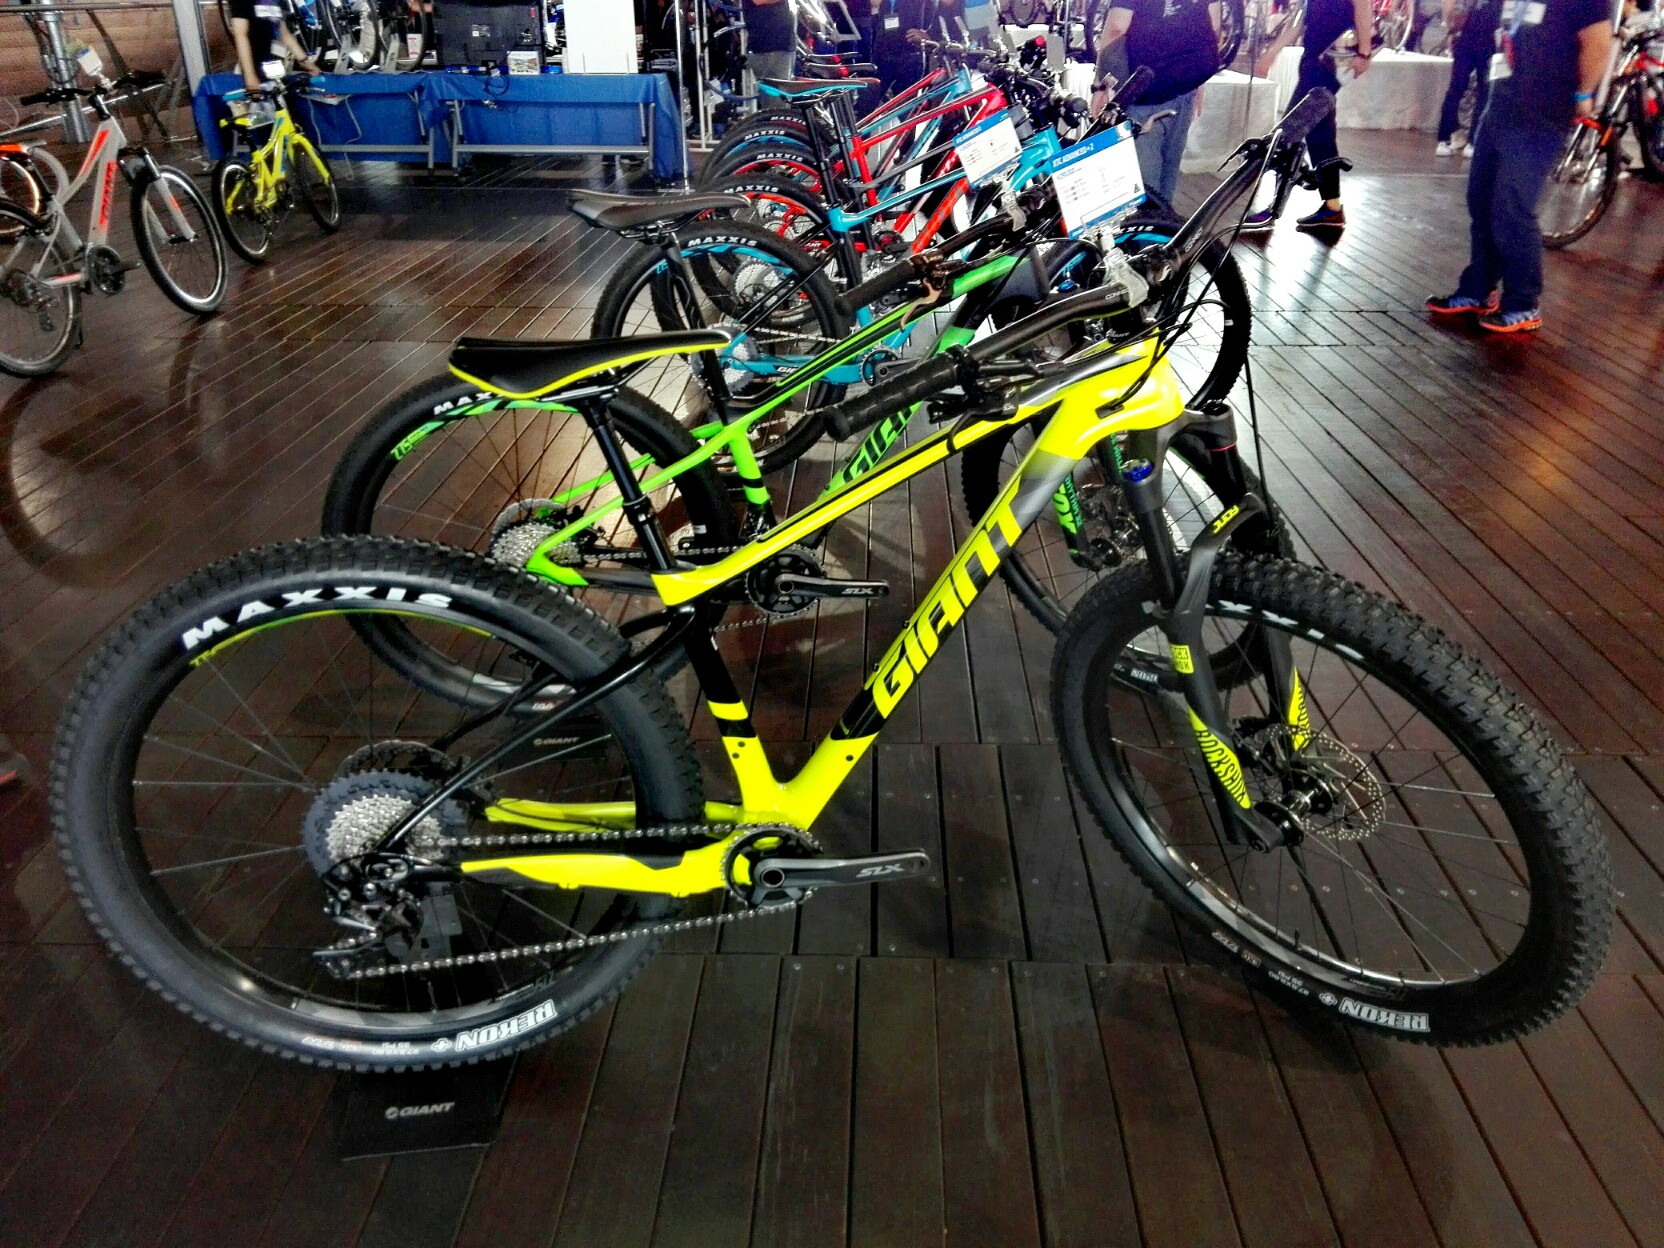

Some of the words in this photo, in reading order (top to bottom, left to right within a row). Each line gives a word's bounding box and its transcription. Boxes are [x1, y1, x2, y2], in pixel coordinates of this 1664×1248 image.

[744, 129, 785, 141] MAXXIS
[756, 152, 803, 162] MAXXIS
[724, 185, 779, 194] MAXXIS
[688, 235, 757, 247] MAXXIS
[433, 391, 504, 416] MAX
[841, 586, 875, 596] SLX
[872, 475, 1023, 719] GIANT
[183, 586, 452, 650] MAXXIS
[1205, 600, 1364, 660] XXIS
[1194, 730, 1246, 802] ROCKSHOX
[855, 862, 906, 879] SLX
[455, 998, 557, 1051] REKON
[1338, 997, 1430, 1032] REKON
[400, 1102, 455, 1117] GIANT
